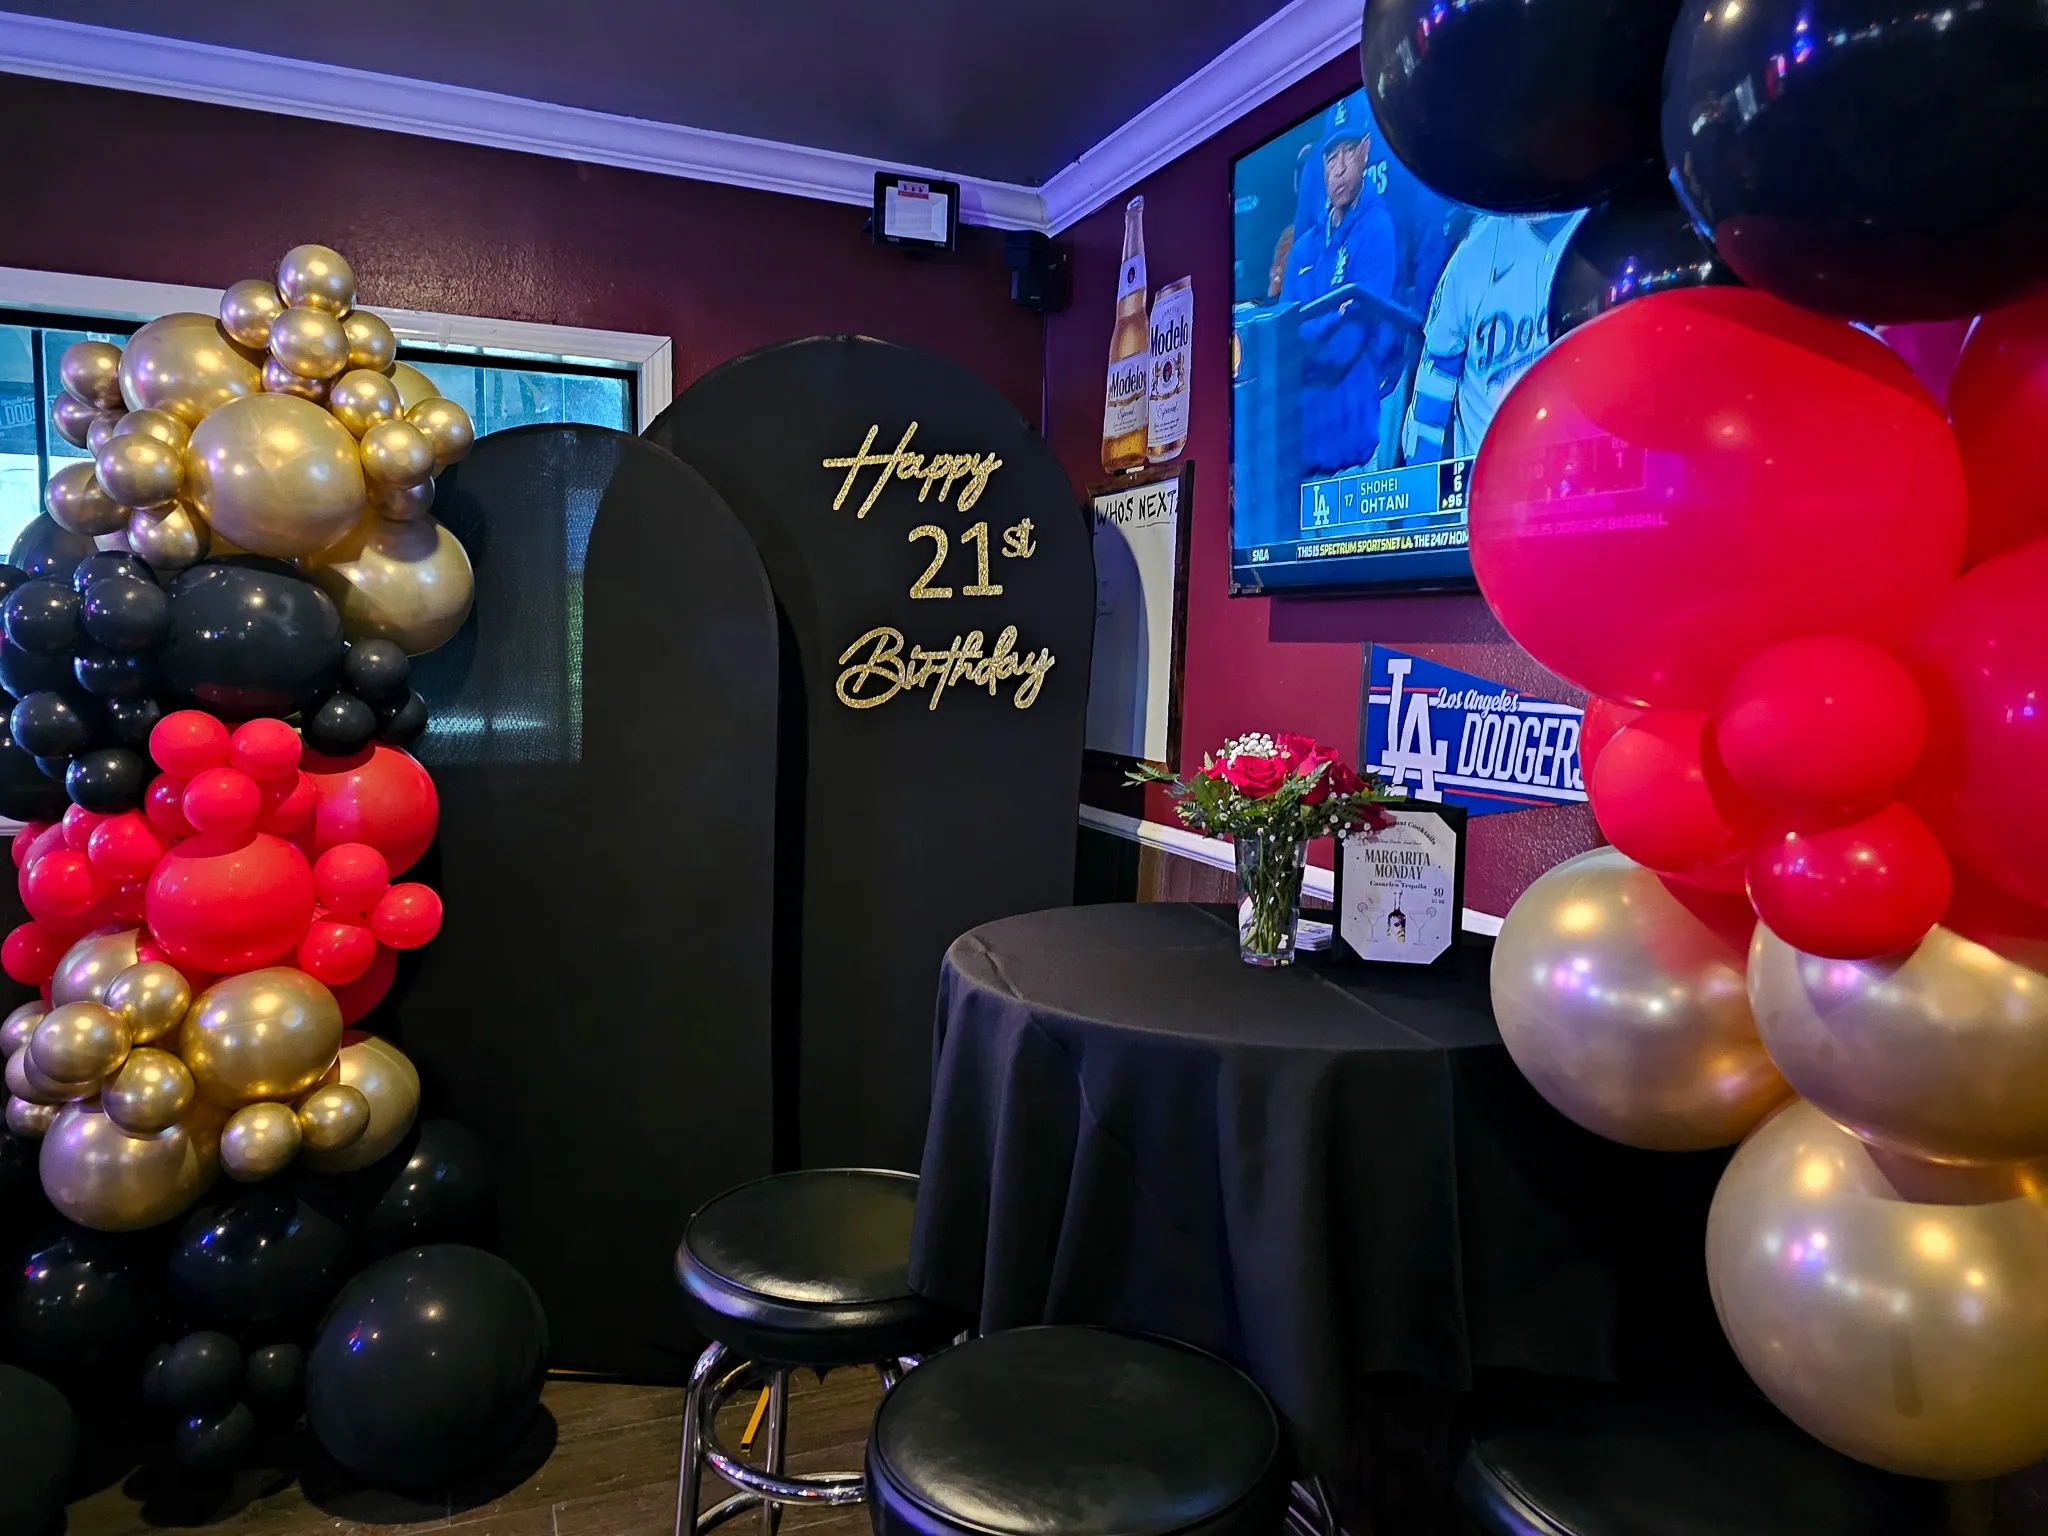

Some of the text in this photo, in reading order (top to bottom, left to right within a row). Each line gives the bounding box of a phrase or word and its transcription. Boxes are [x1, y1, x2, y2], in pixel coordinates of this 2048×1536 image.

[1150, 314, 1189, 358] Modelo
[1110, 365, 1144, 400] Modelo
[823, 421, 1003, 519] Happy
[1454, 462, 1465, 475] IP
[1360, 477, 1399, 497] SHOHEI
[1453, 475, 1463, 491] 6
[1312, 485, 1330, 526] LA
[1344, 494, 1354, 508] 17
[1360, 493, 1410, 515] OHTANI
[1447, 494, 1463, 508] 96
[1251, 548, 1270, 562] SNLA
[1297, 545, 1312, 559] THIS
[1312, 545, 1320, 557] IS
[1319, 540, 1357, 556] SPECTRUM
[1357, 537, 1401, 554] SPORTSNET
[1413, 534, 1430, 548] THE
[1430, 532, 1449, 546] 24/7
[908, 517, 1037, 600] 21st
[836, 625, 1056, 711] Birthday
[1436, 686, 1520, 719] Los Angeles
[1382, 658, 1448, 803] LA
[1364, 848, 1431, 867] MARGARITA
[1374, 863, 1424, 881] MONDAY
[1401, 881, 1428, 890] Tequila
[1432, 887, 1445, 898] $9
